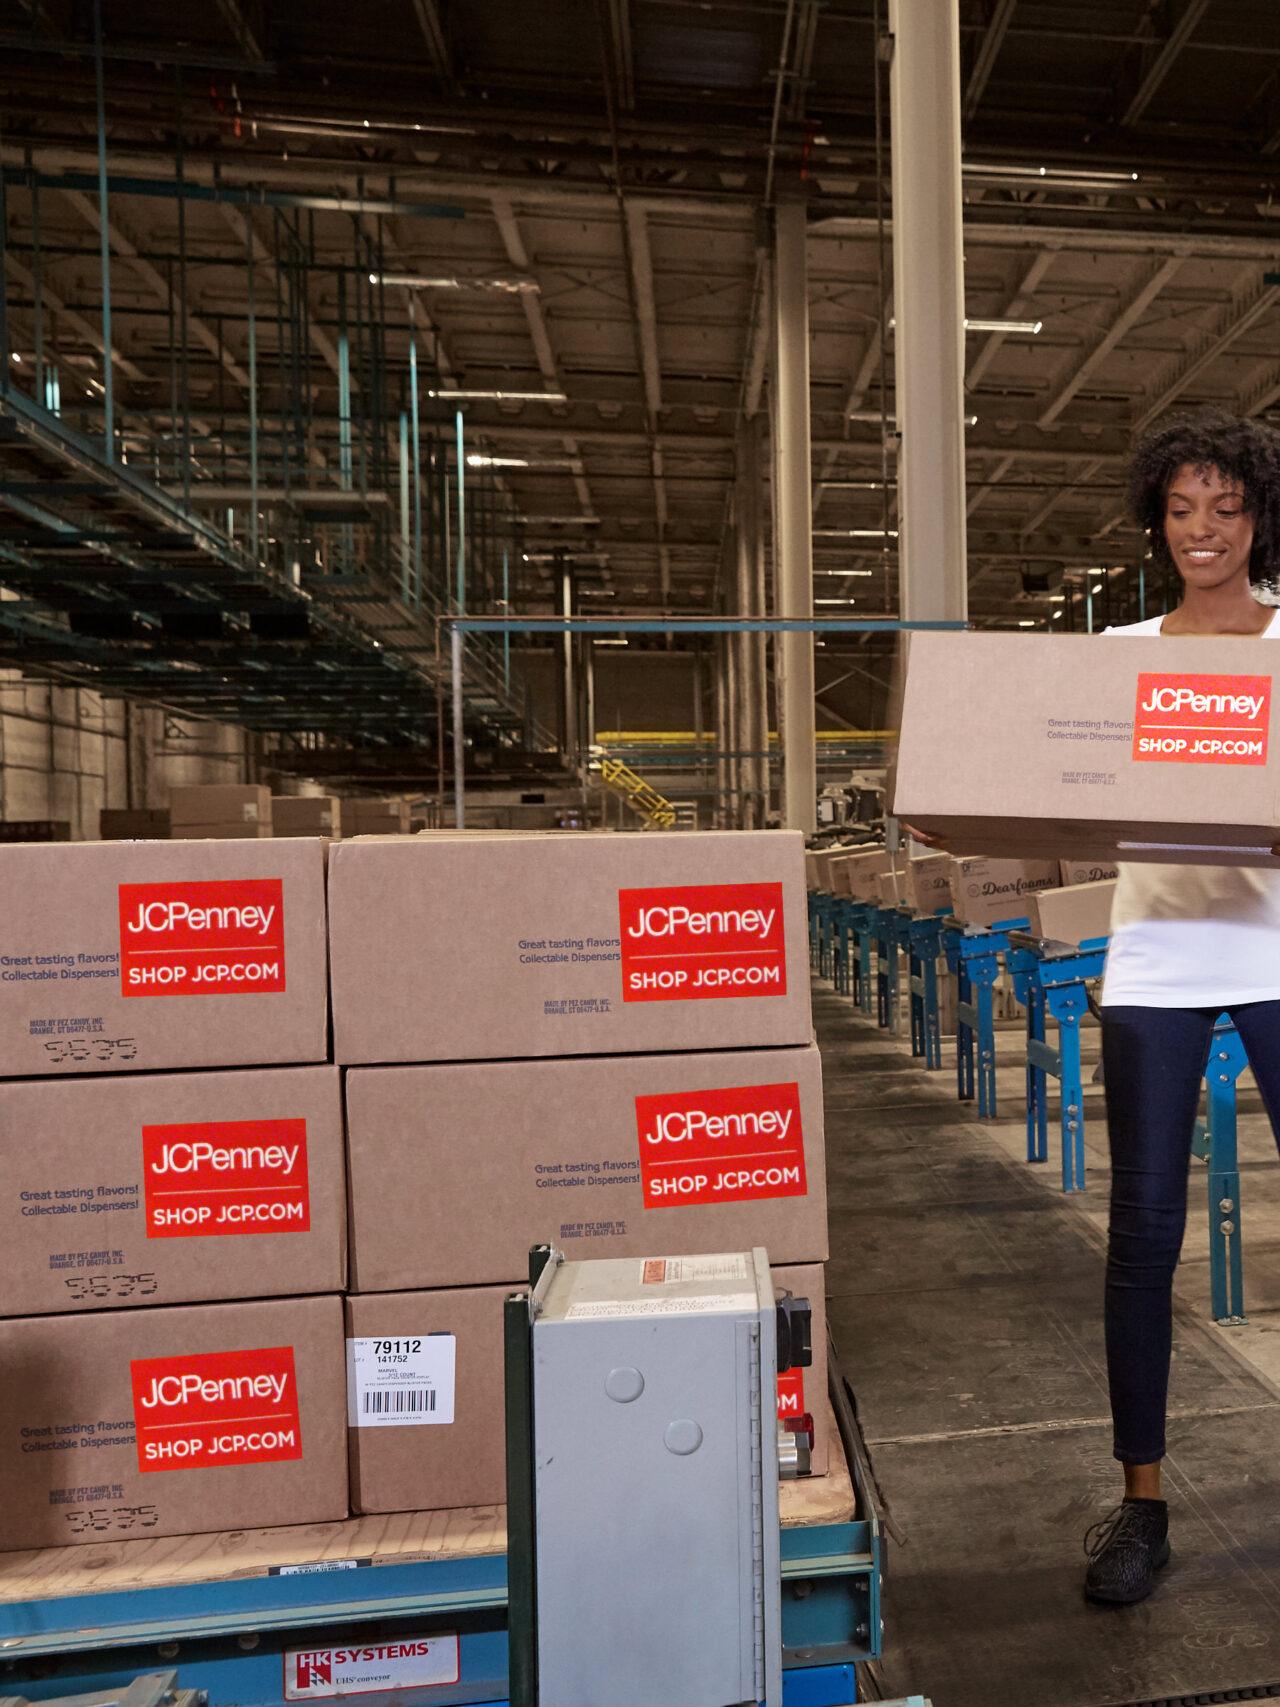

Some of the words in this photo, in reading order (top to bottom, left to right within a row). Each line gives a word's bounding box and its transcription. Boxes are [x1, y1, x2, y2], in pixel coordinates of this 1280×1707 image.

[1142, 687, 1264, 720] JCPenney
[1048, 719, 1070, 728] Great
[1073, 720, 1101, 730] tasting
[1047, 731, 1087, 740] Collectable
[1138, 738, 1188, 754] SHOP
[1189, 739, 1263, 756] JCP.COM
[128, 901, 274, 935] JCPenney
[628, 907, 776, 938] JCPenney
[518, 940, 546, 949] Great
[549, 939, 584, 950] tasting
[1, 956, 32, 966] Great
[36, 955, 75, 966] tasting
[78, 953, 119, 963] flavors!
[520, 954, 568, 964] Collectable
[2, 970, 58, 981] Collectable
[61, 968, 119, 980] Dispensers!
[129, 967, 187, 985] SHOP
[192, 963, 279, 983] JCP.COM
[630, 971, 688, 990] SHOP
[693, 966, 780, 987] JCP.COM
[646, 1109, 793, 1144] JCPenney
[152, 1143, 298, 1174] JCPenney
[535, 1164, 562, 1174] Great
[565, 1162, 600, 1173] tasting
[603, 1160, 640, 1170] flavors!
[536, 1178, 585, 1188] Collectable
[588, 1174, 640, 1186] Dispensers!
[650, 1174, 708, 1196] SHOP
[713, 1166, 800, 1190] JCP.COM
[20, 1191, 52, 1201] Great
[55, 1188, 94, 1200] tasting
[97, 1185, 139, 1196] flavors!
[21, 1205, 77, 1216] Collectable
[80, 1200, 139, 1213] Dispensers!
[154, 1207, 211, 1226] SHOP
[216, 1202, 303, 1223] JCP.COM
[373, 1340, 421, 1354] 79112
[377, 1355, 408, 1363] 141752
[142, 1373, 288, 1408] JCPenney
[20, 1426, 52, 1438] Great
[55, 1423, 95, 1435] tasting
[21, 1440, 78, 1453] Collectable
[145, 1437, 203, 1460] SHOP
[208, 1429, 295, 1455] JCP.COM
[299, 1652, 331, 1668] HK
[335, 1642, 429, 1664] SYSTEMS
[357, 1674, 391, 1683] conveyor
